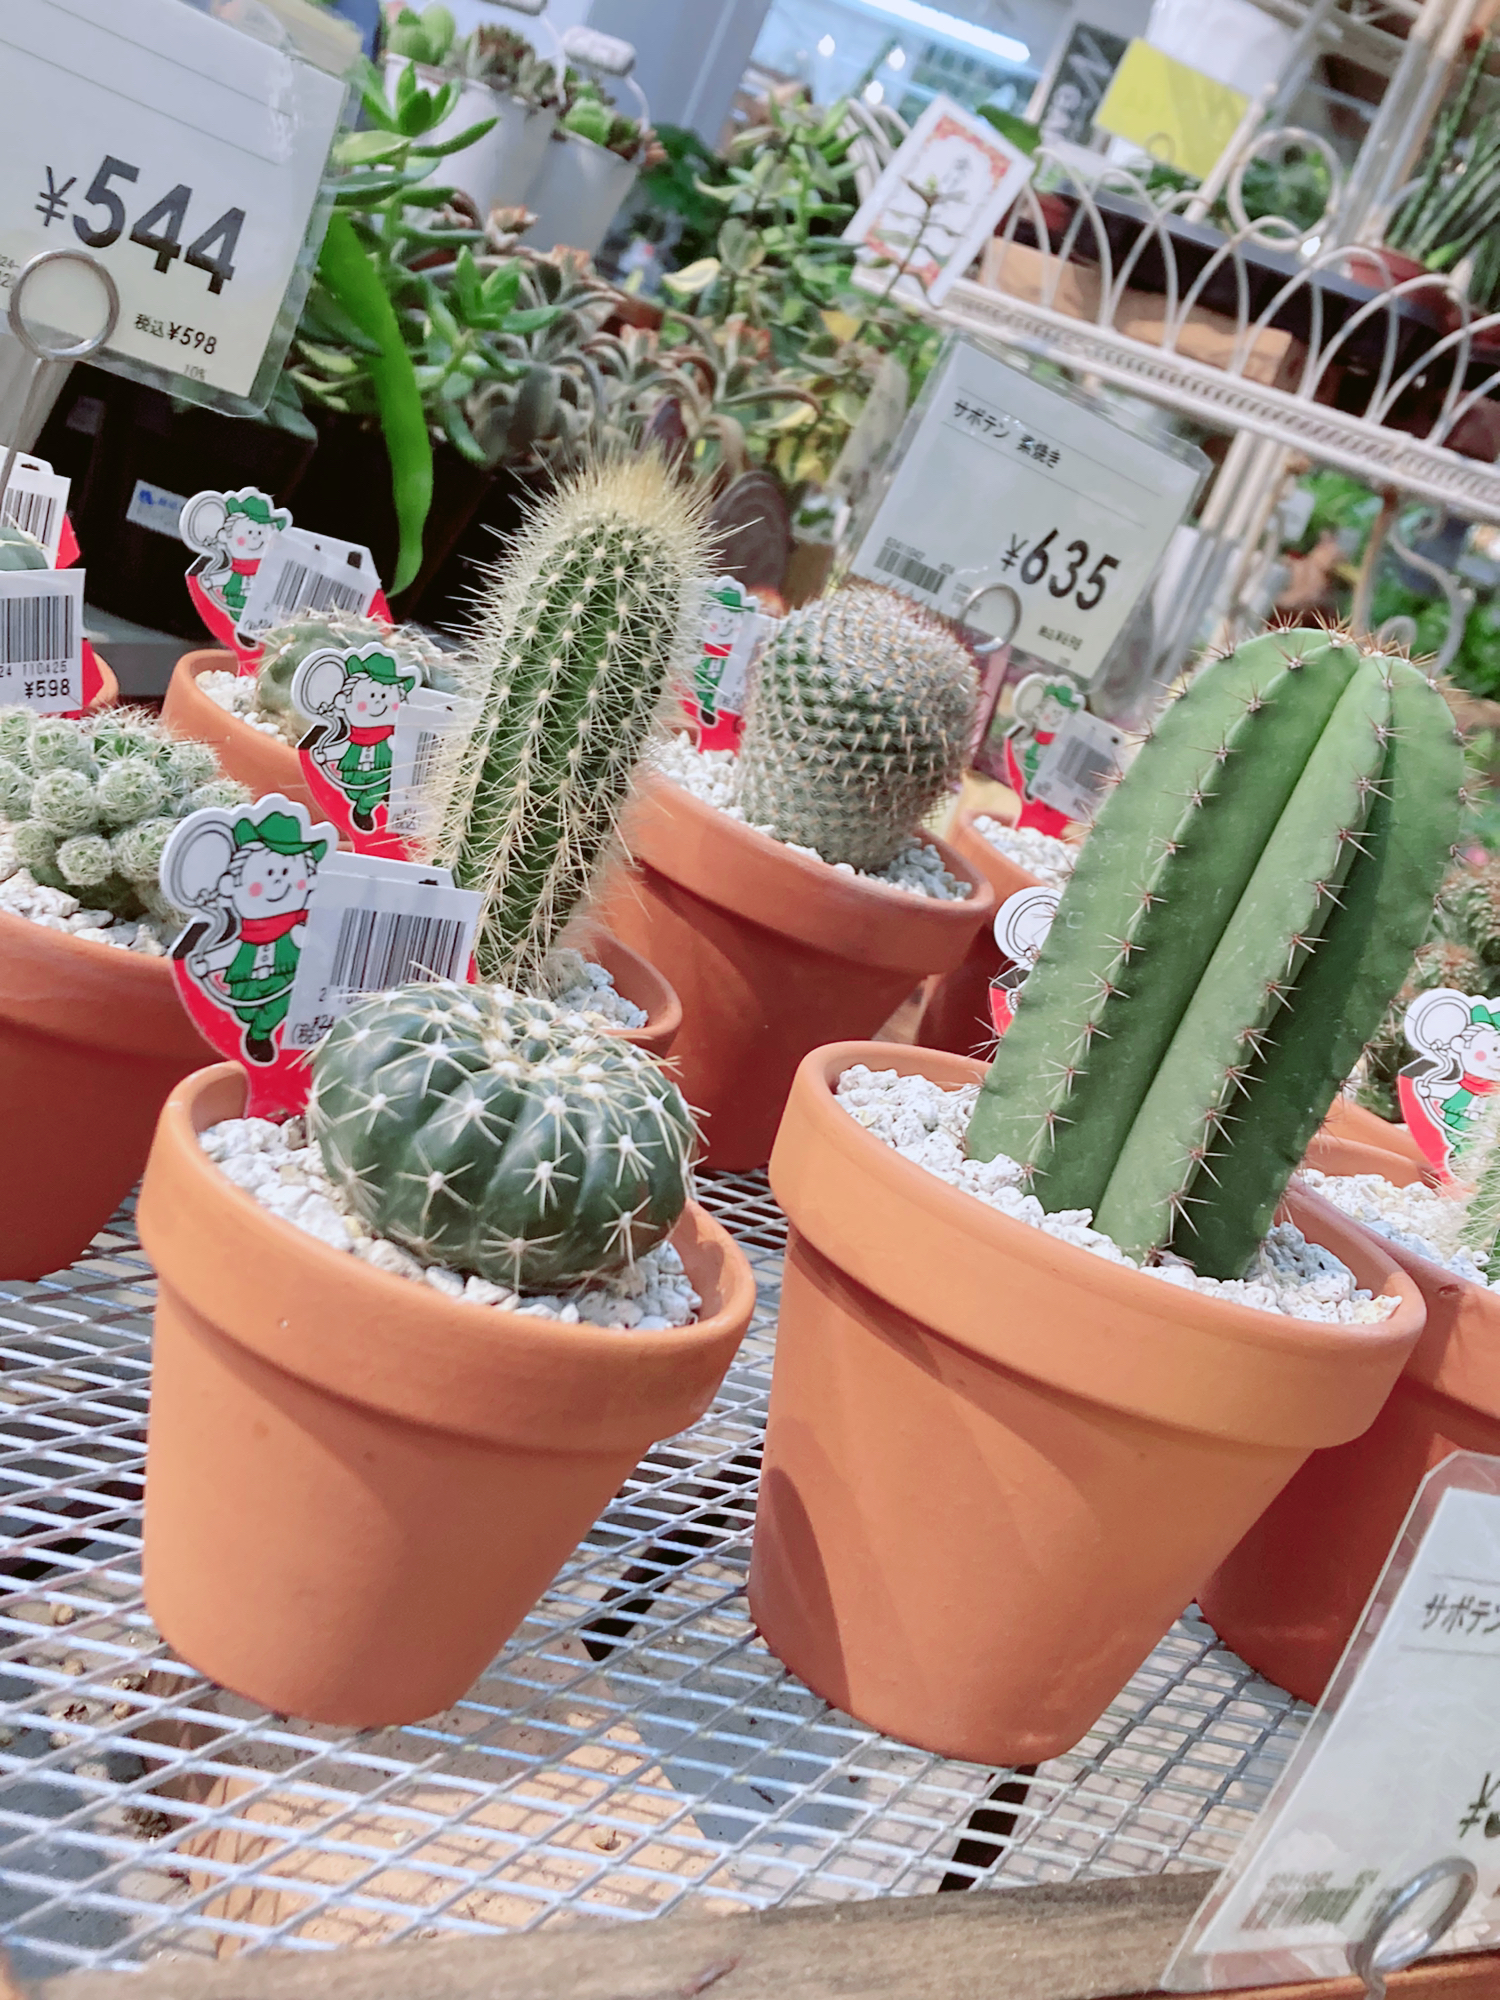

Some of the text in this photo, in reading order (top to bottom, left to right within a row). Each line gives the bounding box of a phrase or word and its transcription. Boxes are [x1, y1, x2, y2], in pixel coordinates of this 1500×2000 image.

[35, 155, 246, 294] ¥544
[954, 399, 1010, 438] サボテン
[1001, 527, 1119, 610] ¥635
[24, 678, 70, 699] ¥598
